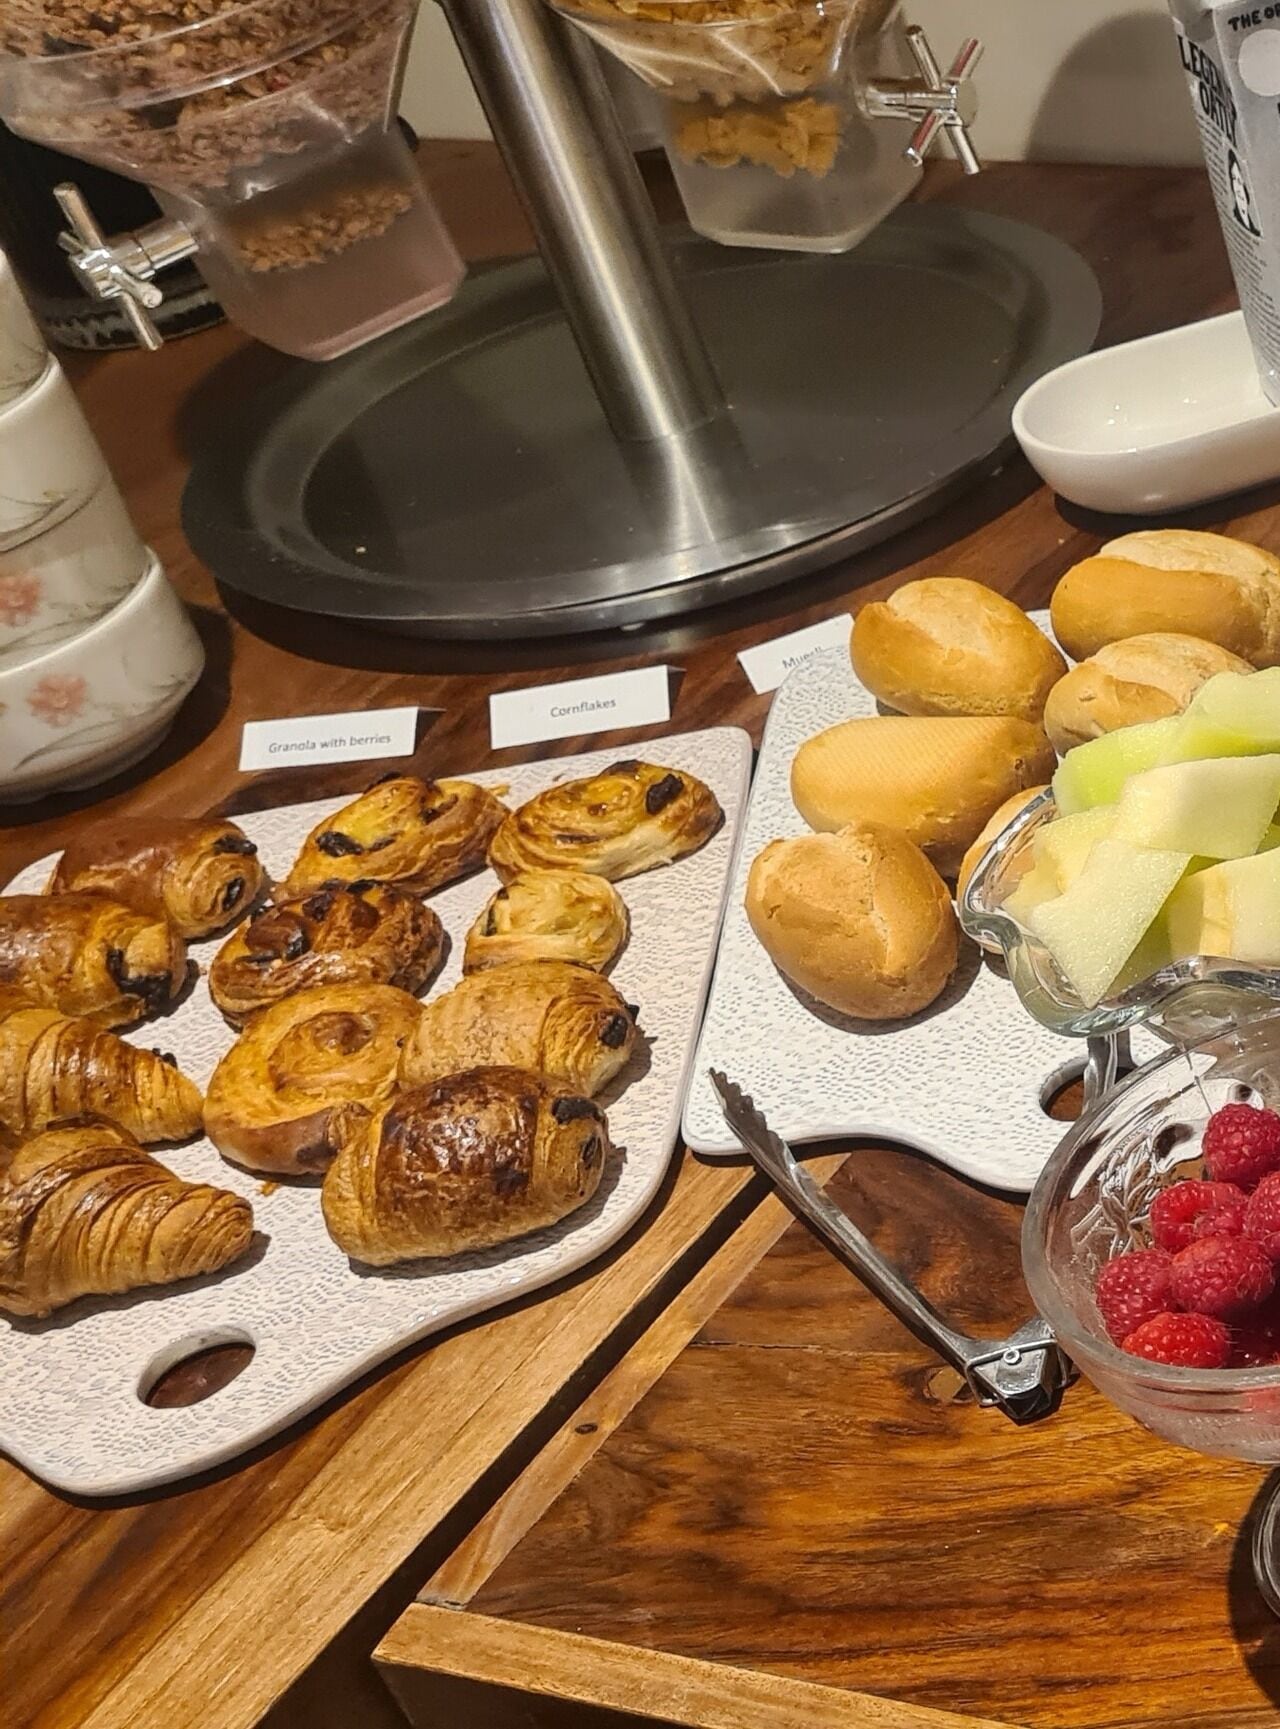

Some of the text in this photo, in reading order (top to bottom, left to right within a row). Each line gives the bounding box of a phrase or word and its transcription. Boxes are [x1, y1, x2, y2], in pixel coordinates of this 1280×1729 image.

[1228, 10, 1262, 32] THE
[550, 698, 617, 718] Cornflakes
[268, 733, 392, 754] Granola with berries
